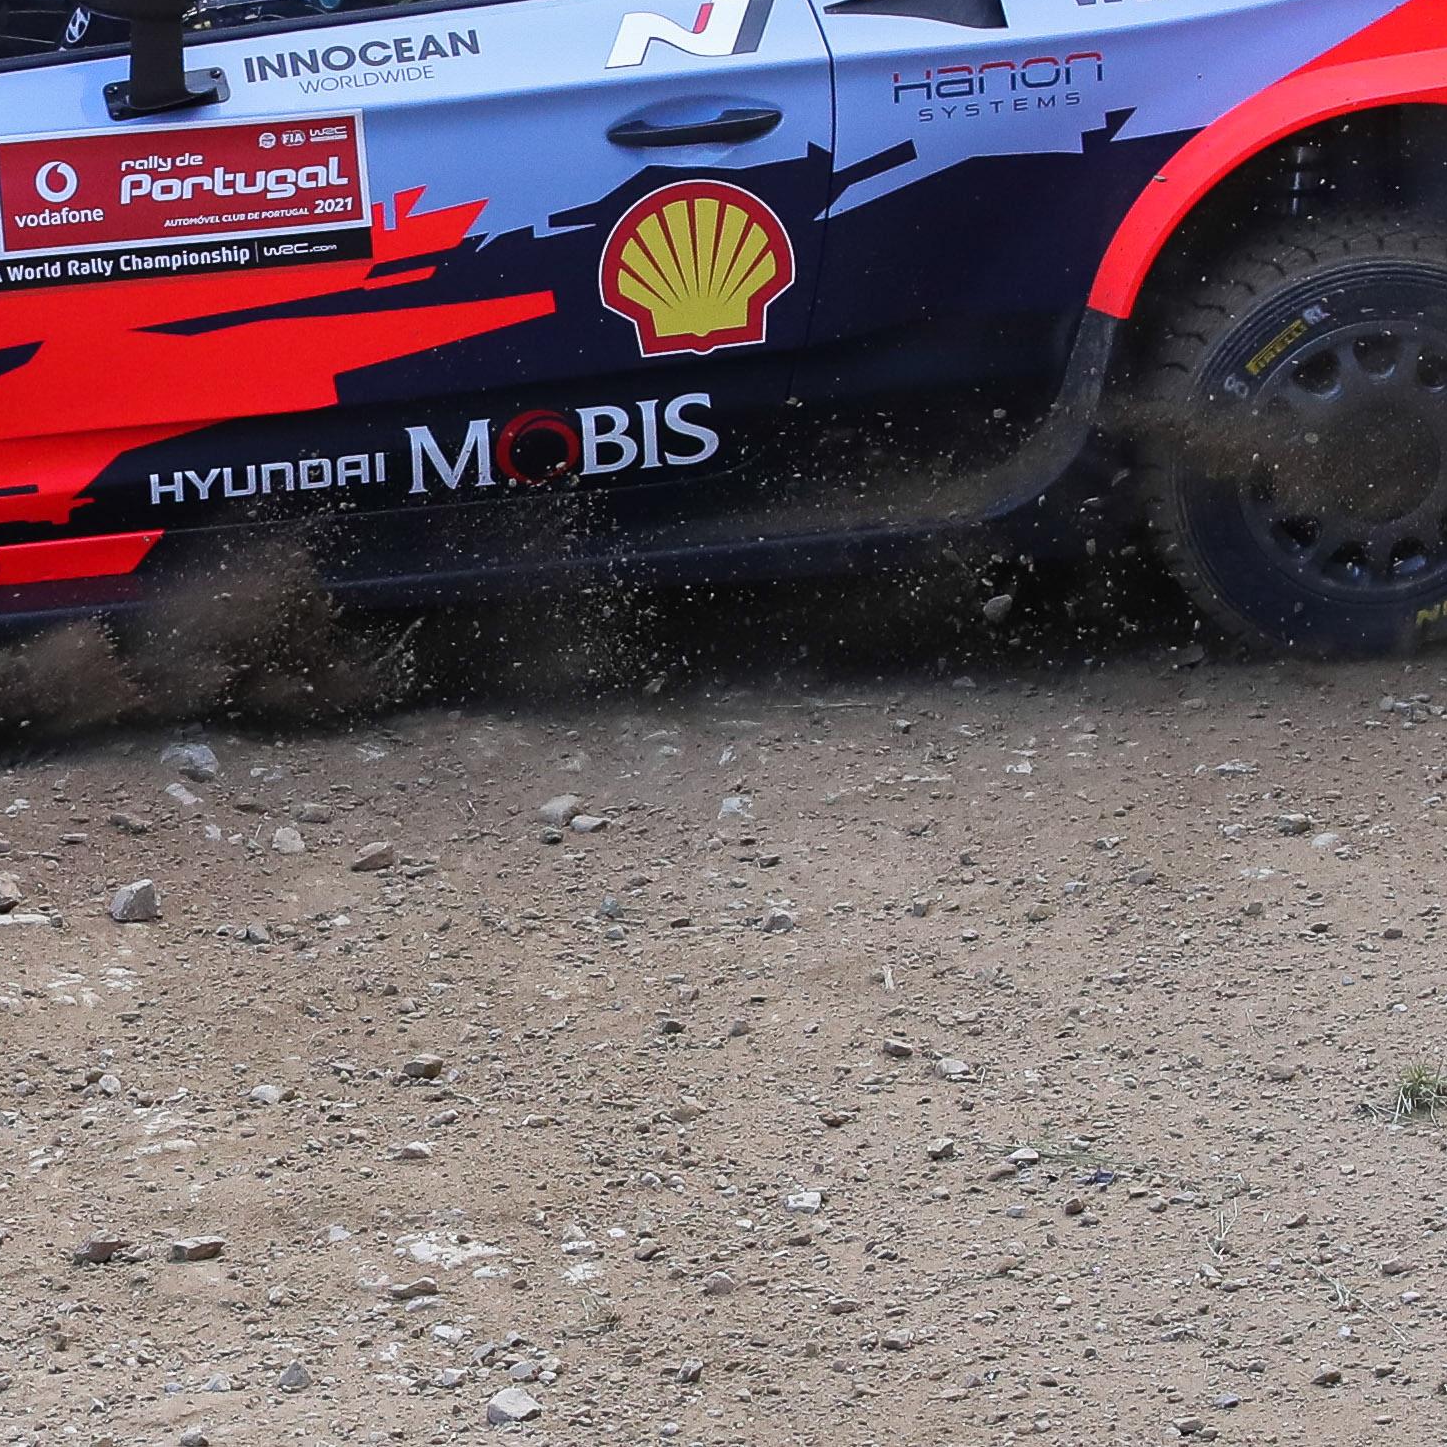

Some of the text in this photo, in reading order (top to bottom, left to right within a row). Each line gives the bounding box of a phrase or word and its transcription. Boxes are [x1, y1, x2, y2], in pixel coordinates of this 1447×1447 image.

[244, 29, 481, 84] INNOCEAN
[299, 65, 435, 94] WORLDWIDE
[918, 92, 1082, 123] SYSTEMS
[120, 151, 203, 173] rally de
[119, 156, 349, 205] Portugal
[14, 204, 104, 229] vodafone
[222, 211, 245, 222] CLUB
[248, 211, 260, 220] DE
[262, 207, 310, 218] PORTUGAL
[314, 197, 353, 214] 2021
[5, 252, 62, 281] World
[67, 247, 113, 278] Rally
[119, 243, 251, 273] Championship
[150, 393, 720, 505] HYUNDAI MOBIS
